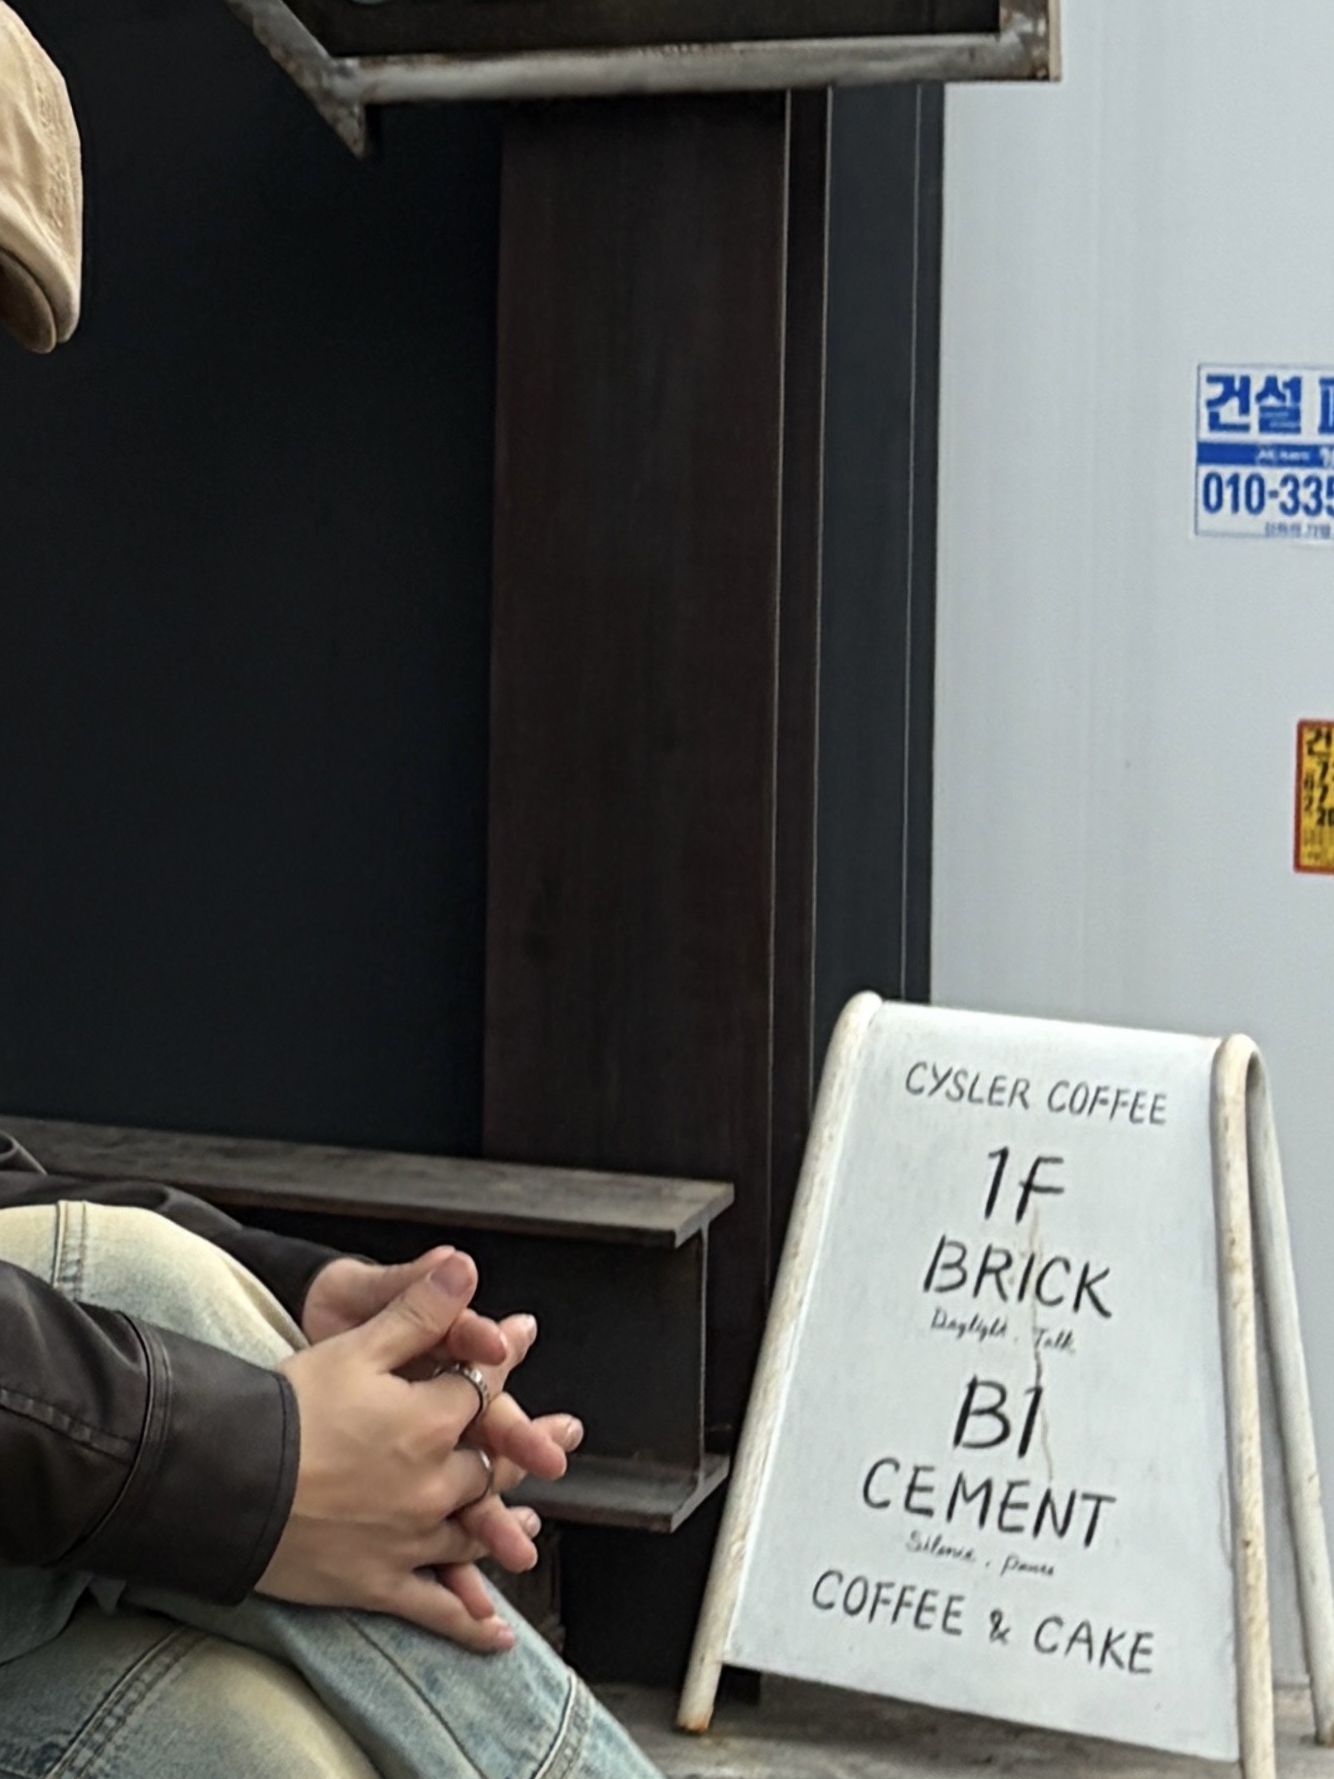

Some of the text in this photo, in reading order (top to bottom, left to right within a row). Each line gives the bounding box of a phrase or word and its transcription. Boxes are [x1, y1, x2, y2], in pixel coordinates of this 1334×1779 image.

[905, 1061, 1167, 1125] CYSLER COFFEE
[984, 1146, 1065, 1224] 1F
[922, 1234, 1112, 1319] BRICK
[953, 1374, 1044, 1459] B1
[862, 1457, 1117, 1548] CEMENT
[812, 1569, 1154, 1675] COFFEE & CAKE
